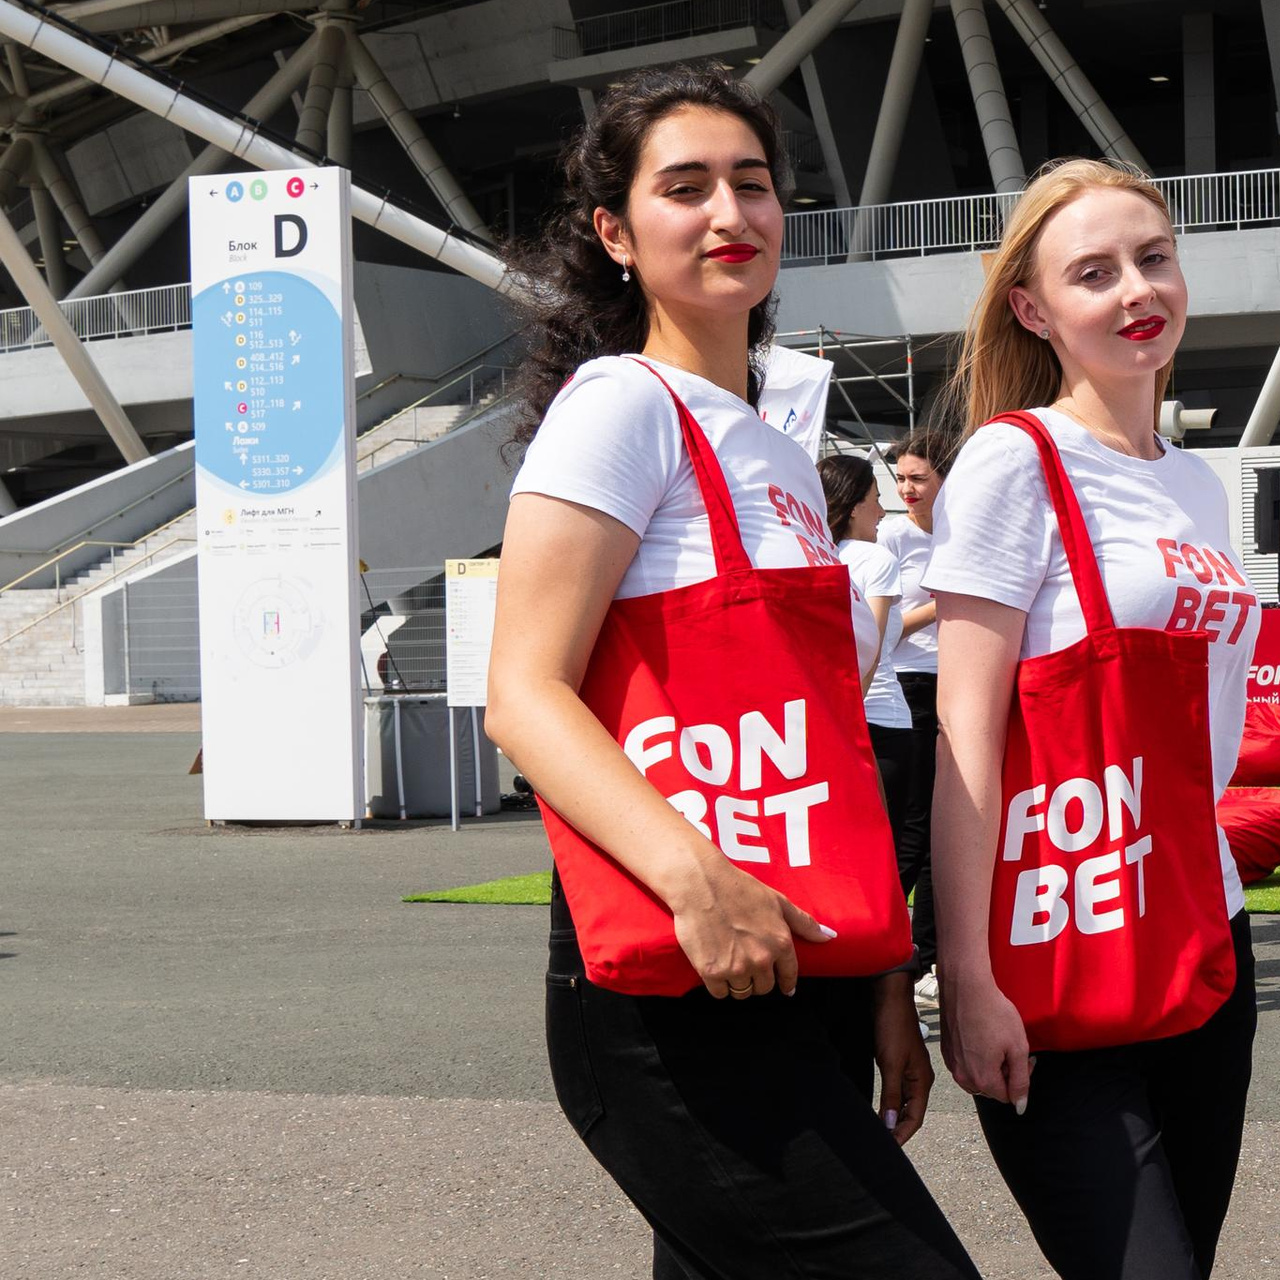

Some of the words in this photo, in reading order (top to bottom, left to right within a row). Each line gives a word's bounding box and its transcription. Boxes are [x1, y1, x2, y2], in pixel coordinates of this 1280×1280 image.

[228, 240, 258, 252] Блок
[274, 214, 308, 258] D
[240, 509, 260, 517] Лифт
[457, 563, 466, 575] D
[1156, 538, 1246, 586] FON
[1164, 586, 1257, 645] BET
[624, 698, 808, 791] FON
[1003, 756, 1144, 862] FON
[1009, 833, 1153, 947] BET
